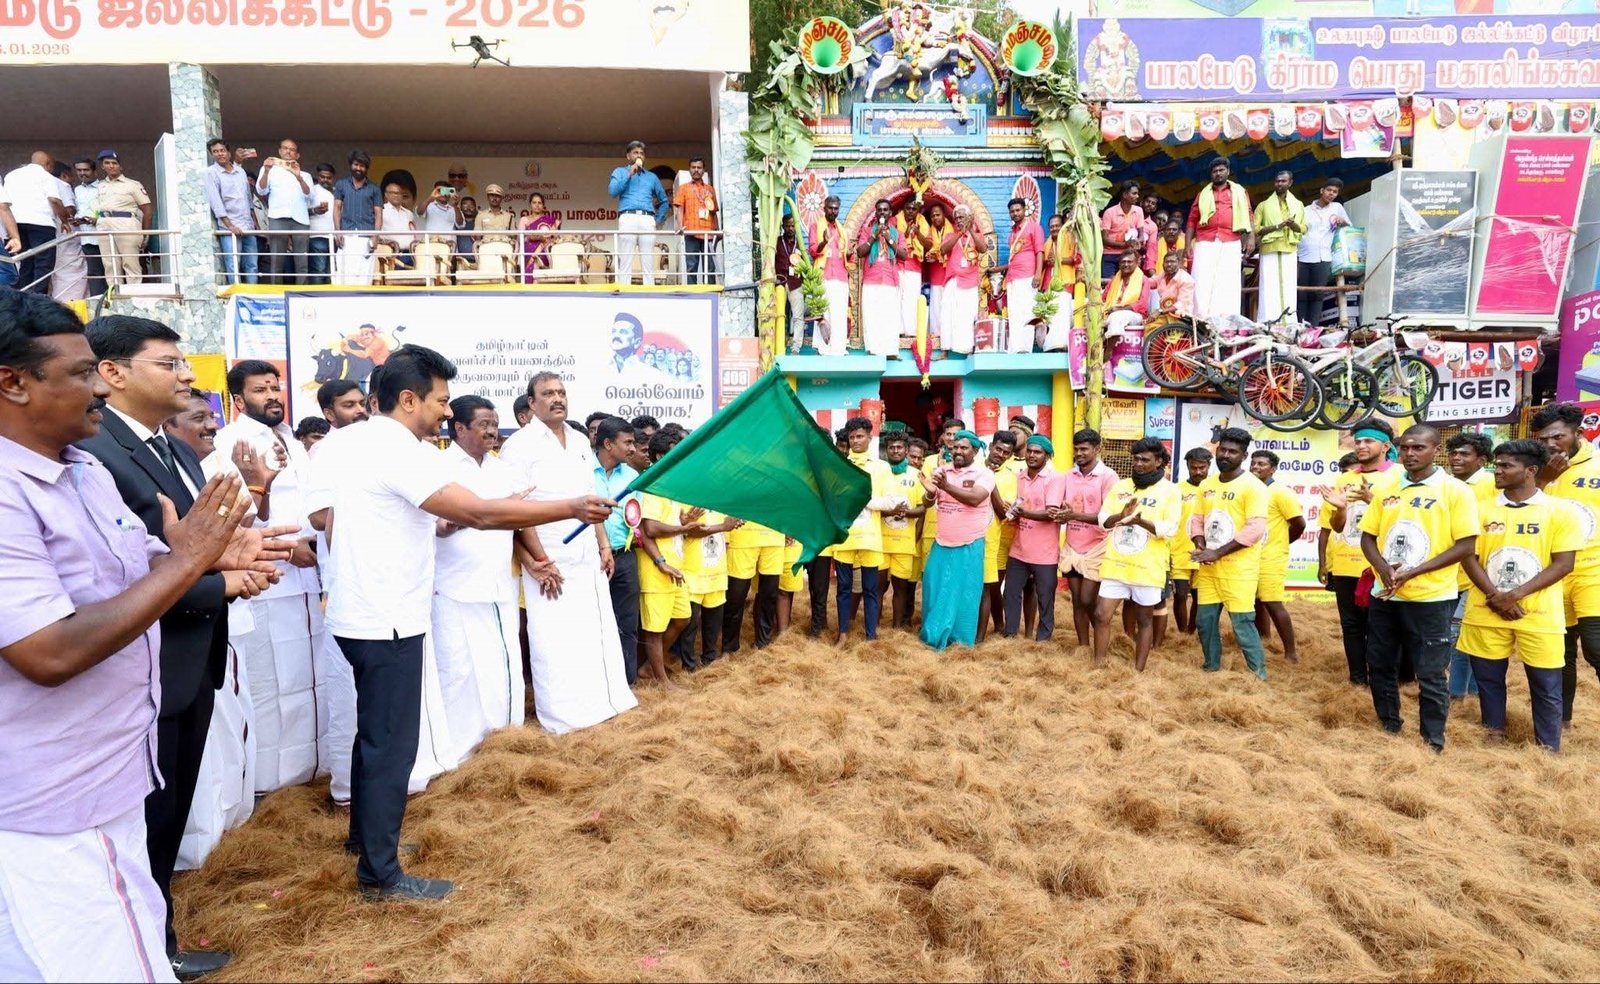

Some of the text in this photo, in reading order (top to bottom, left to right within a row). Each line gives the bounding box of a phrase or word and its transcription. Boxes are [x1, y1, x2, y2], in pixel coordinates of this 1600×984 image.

[446, 0, 585, 28] 2026
[1552, 23, 1600, 44] விழா-
[0, 43, 70, 55] .01.2026
[1146, 54, 1255, 92] பாலமேடு
[1268, 53, 1336, 92] கிராம
[1351, 57, 1423, 94] பொது
[567, 208, 618, 221] பாலமே
[605, 384, 705, 401] வெல்வோம்
[1436, 379, 1511, 402] TIGER
[1429, 406, 1512, 418] FING SHEETS
[1148, 415, 1172, 428] SUPER
[1280, 459, 1325, 476] லமேடு
[1571, 477, 1600, 489] 49
[1221, 491, 1236, 502] 50
[1409, 496, 1437, 509] 47
[1515, 523, 1541, 535] 15
